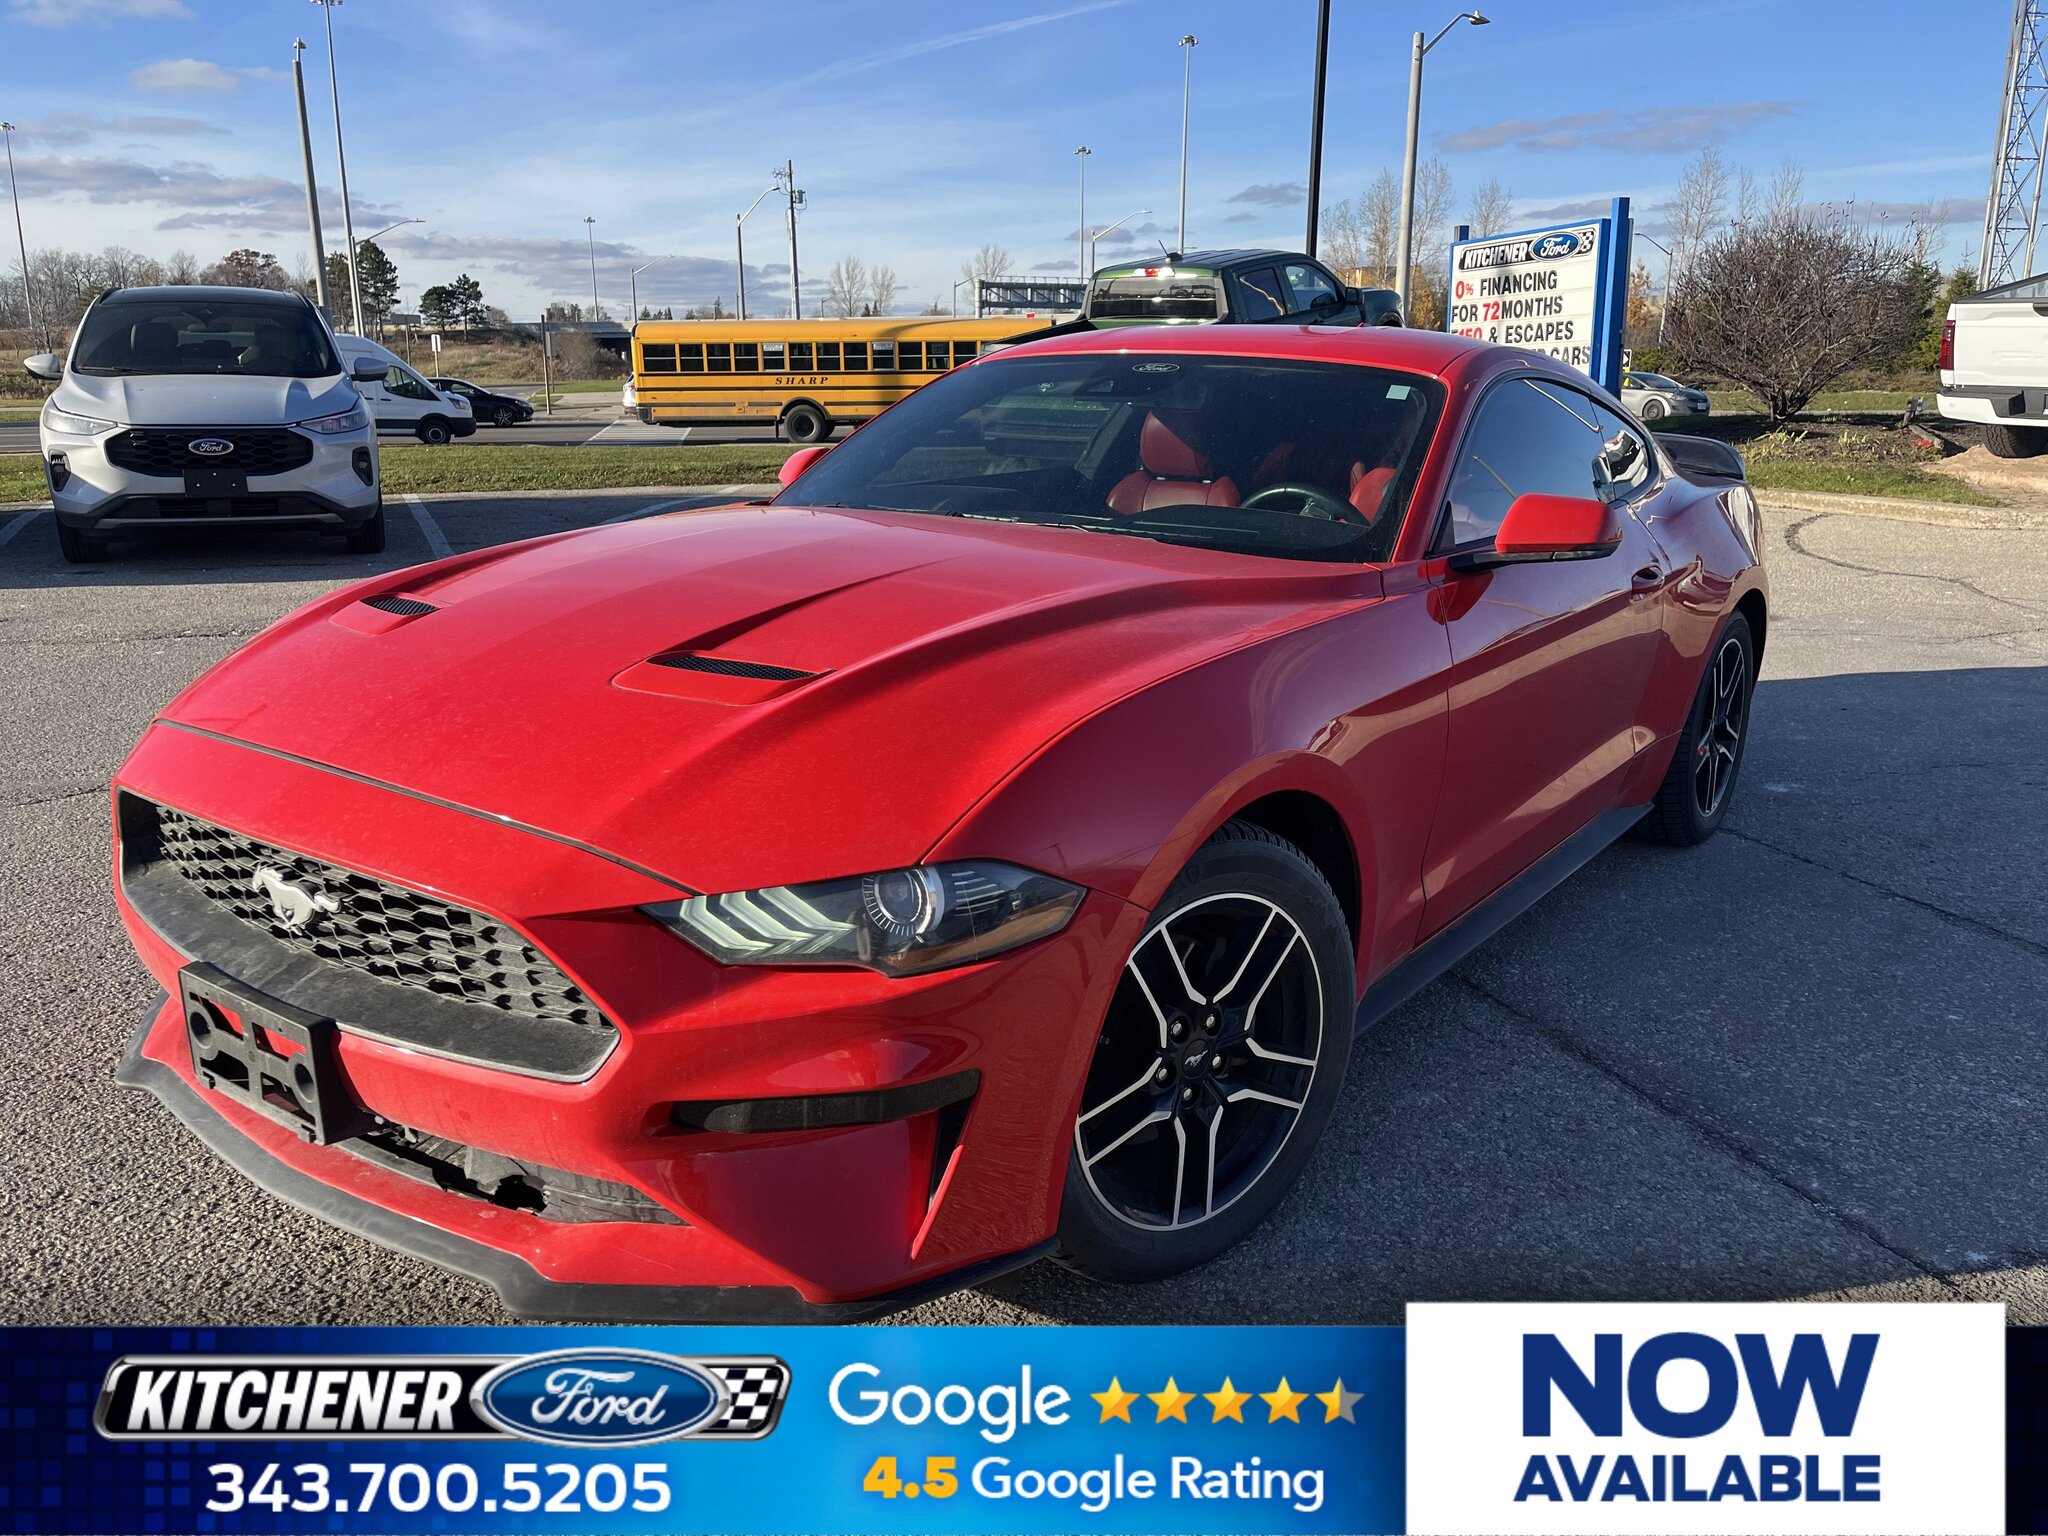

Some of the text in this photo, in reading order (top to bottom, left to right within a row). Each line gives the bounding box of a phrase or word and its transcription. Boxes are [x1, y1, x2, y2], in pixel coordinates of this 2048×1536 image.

[1463, 236, 1570, 269] KITCHENER Ford
[1455, 269, 1558, 299] 0% FINANCING
[1451, 295, 1563, 323] FOR 72 MONTHS
[1451, 321, 1574, 344] 50 & ESCAPES
[775, 376, 829, 385] SHARP
